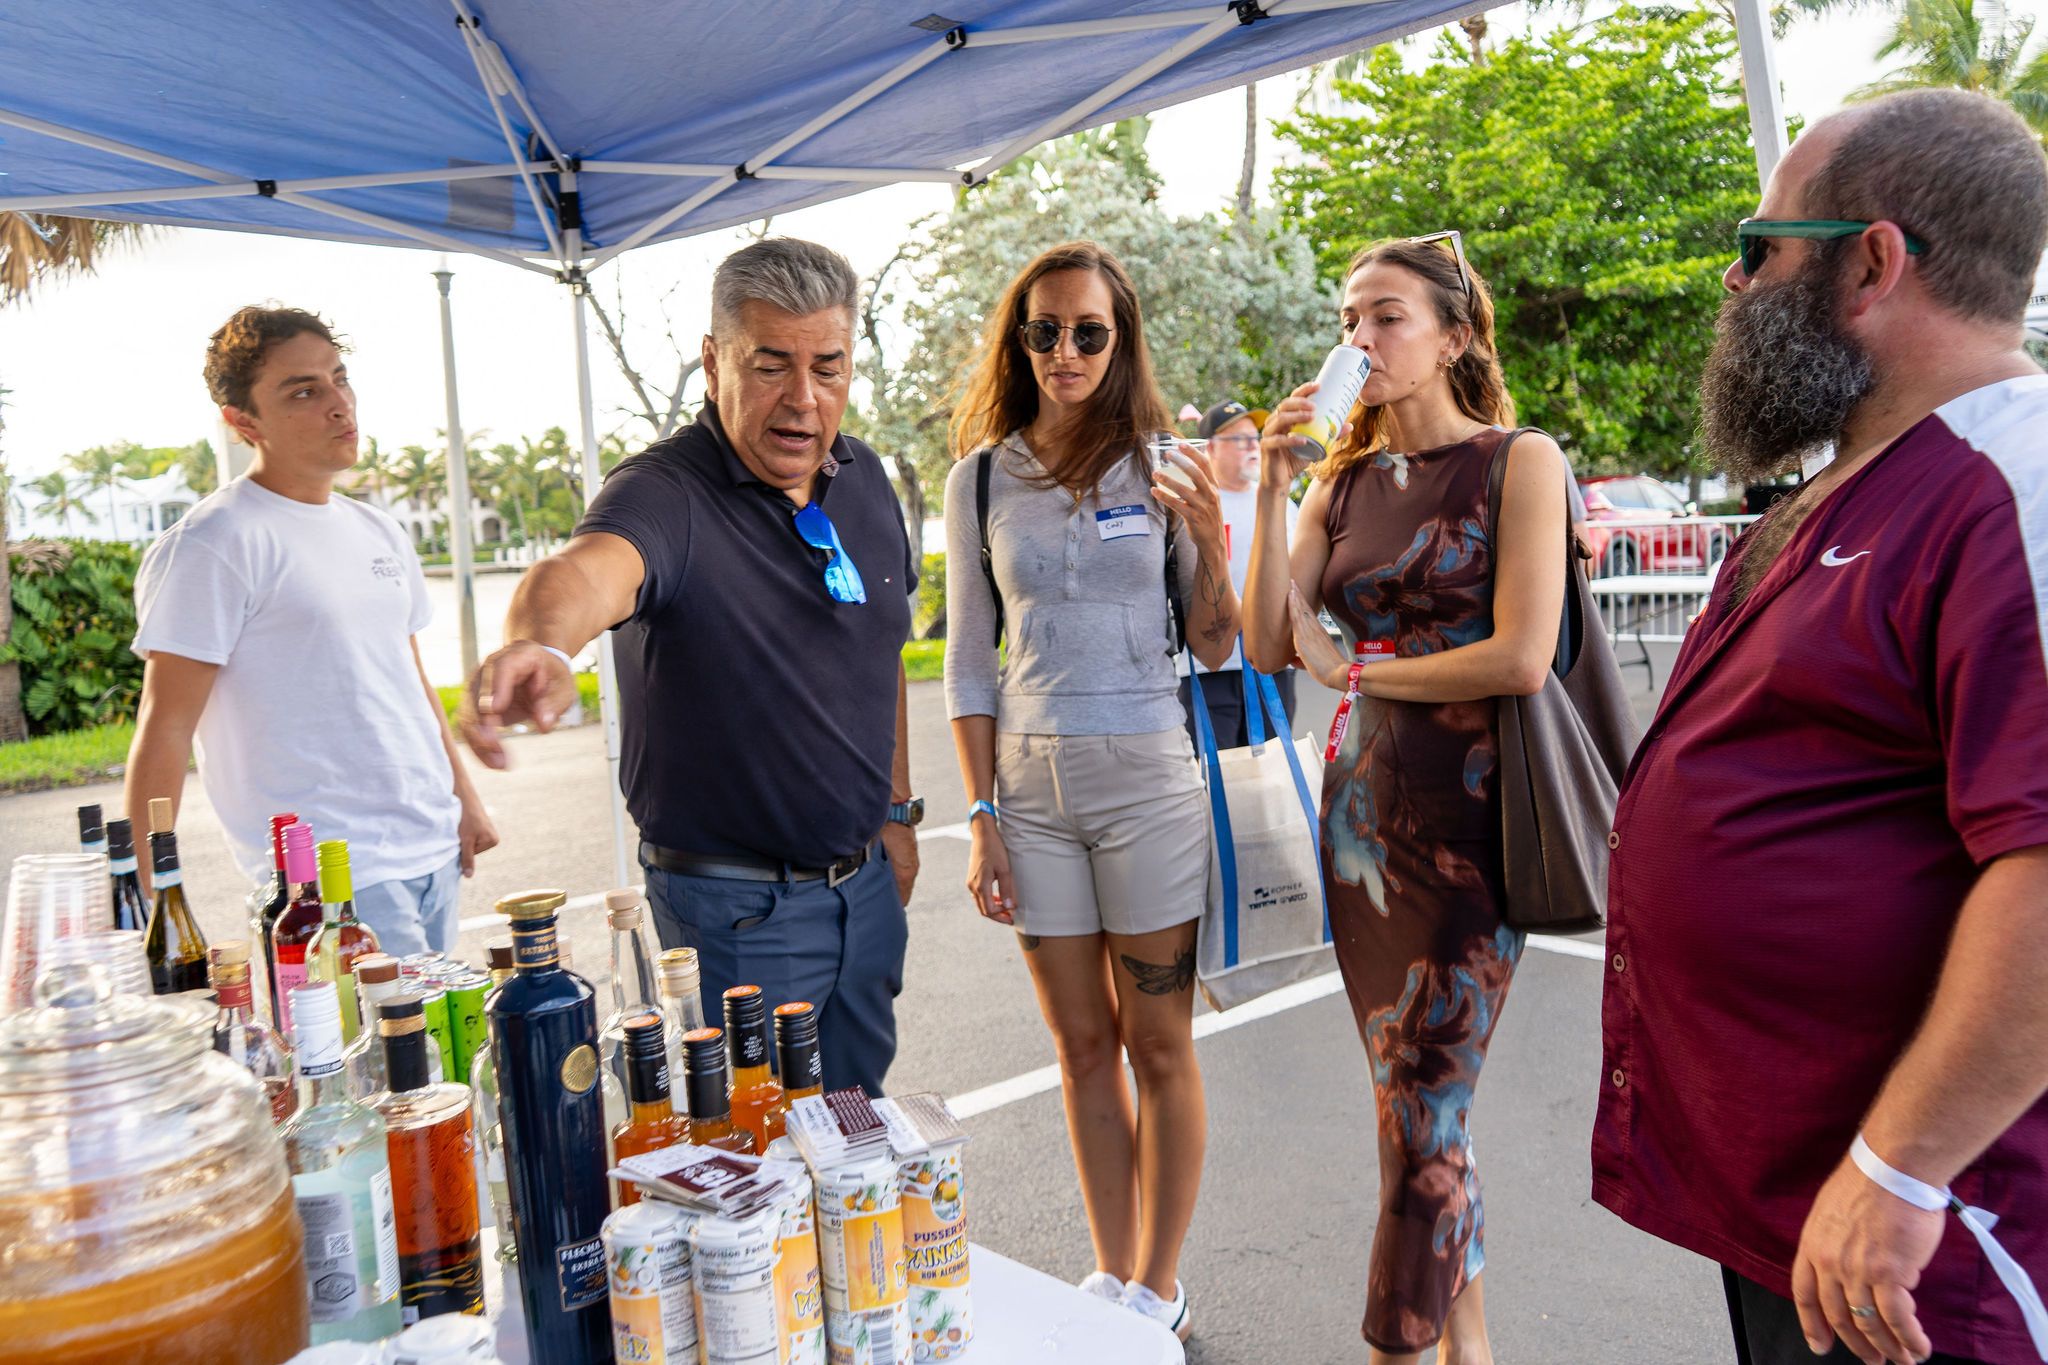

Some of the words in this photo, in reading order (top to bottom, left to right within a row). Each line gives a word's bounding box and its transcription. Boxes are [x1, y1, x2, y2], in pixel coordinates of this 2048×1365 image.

[1110, 507, 1131, 516] HELLO
[1363, 642, 1382, 650] HELLO
[1330, 712, 1347, 747] TRITON
[914, 1220, 963, 1243] PUSSER'S
[921, 1270, 937, 1280] NON
